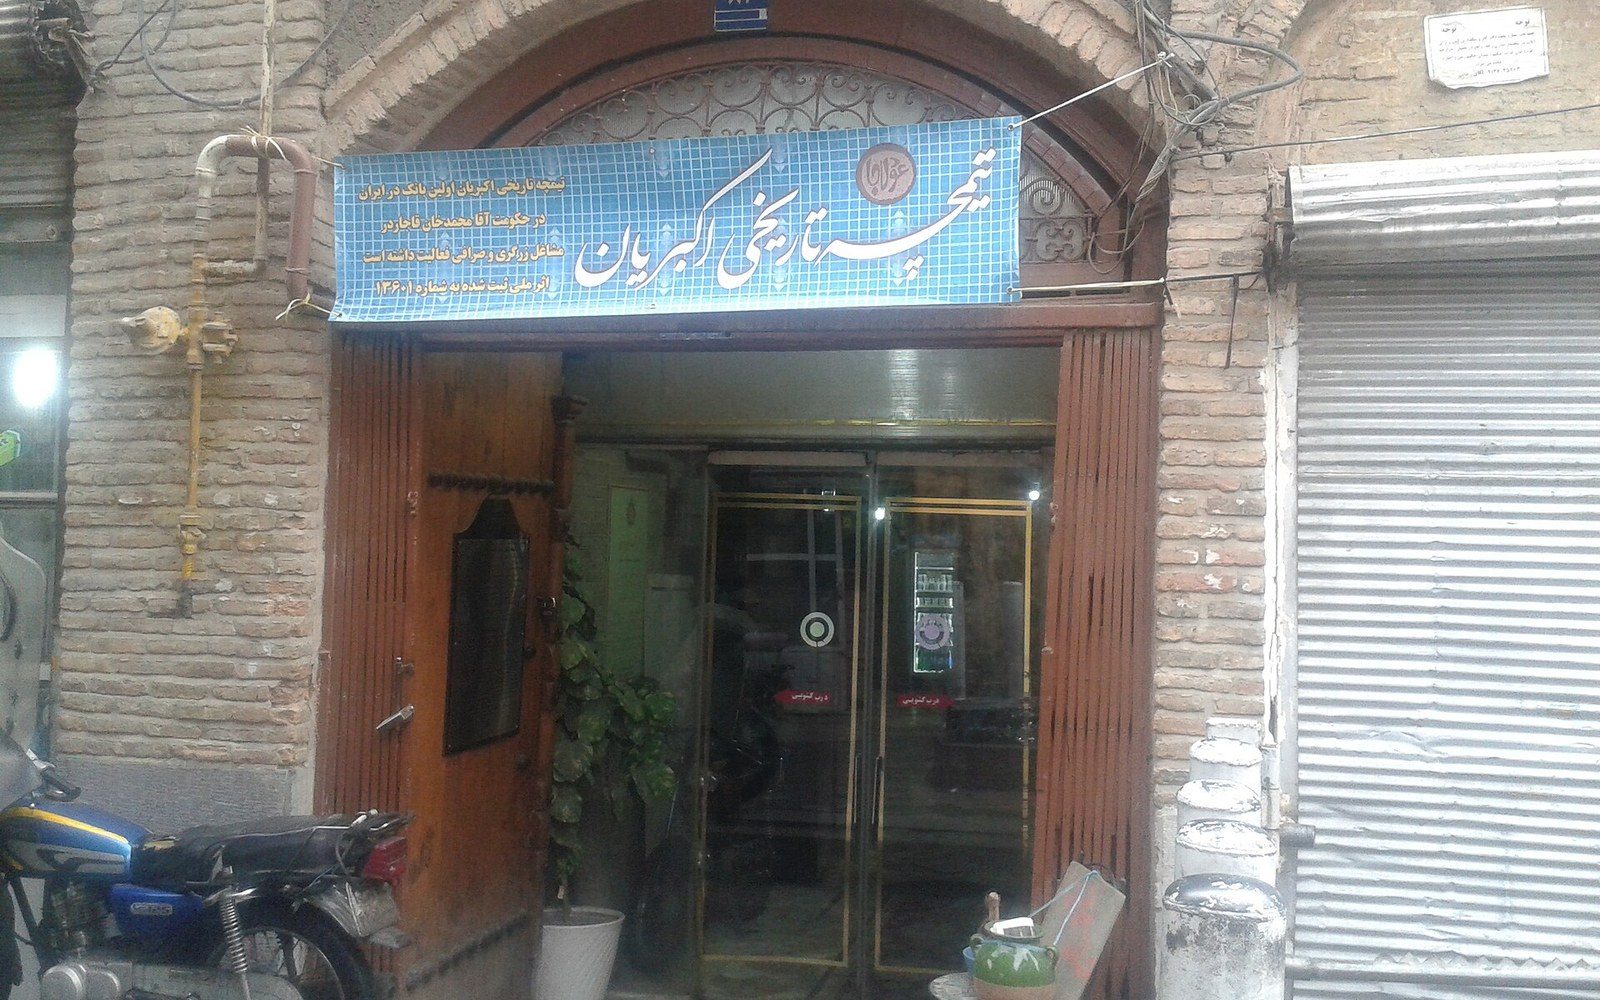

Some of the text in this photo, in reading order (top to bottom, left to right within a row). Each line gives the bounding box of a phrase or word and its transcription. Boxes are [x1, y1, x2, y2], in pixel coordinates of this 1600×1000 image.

[359, 176, 566, 201] تیمچه تاریخی اکبریان اولین بانک در ایران
[475, 211, 491, 226] آقا
[493, 211, 531, 230] حکومت
[533, 213, 547, 229] در
[575, 147, 997, 291] تیمچه تاریخی اکبریان
[363, 243, 565, 264] مشاغل زرگری و صرافی فعالیت داشته است
[416, 279, 448, 297] شماره
[449, 281, 460, 295] به
[461, 278, 485, 292] شده
[487, 276, 509, 293] ثبت
[510, 277, 532, 294] ملی
[533, 275, 550, 292] اثر
